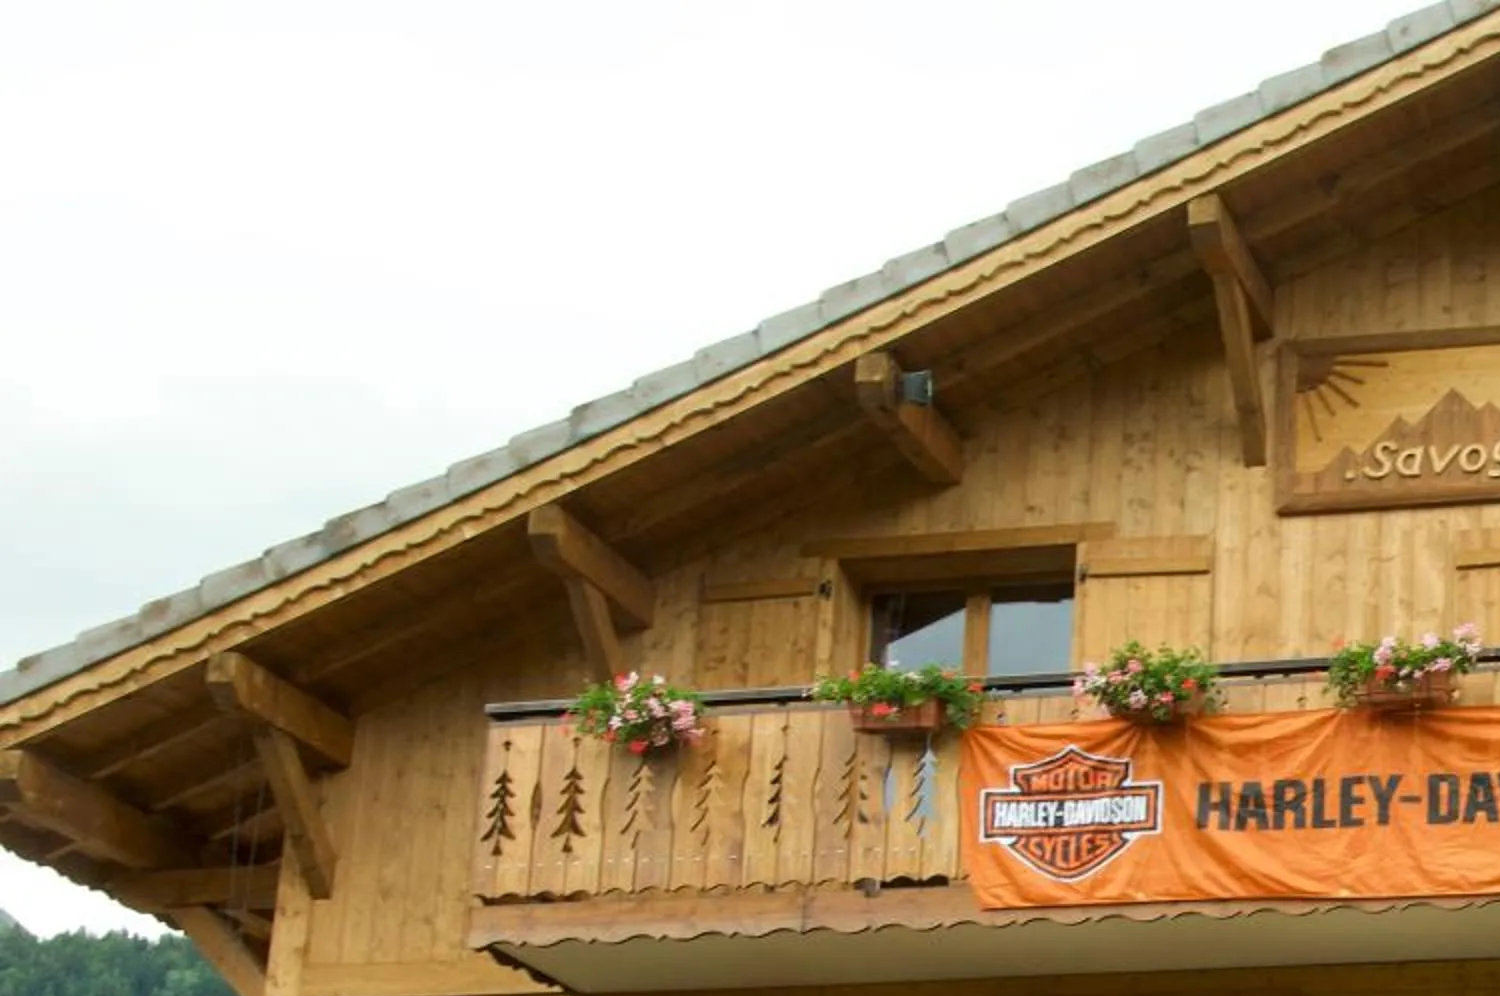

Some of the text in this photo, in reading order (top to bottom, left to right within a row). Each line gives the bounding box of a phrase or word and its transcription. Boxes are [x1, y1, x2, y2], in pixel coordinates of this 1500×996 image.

[1030, 762, 1113, 792] MOTOR
[993, 795, 1148, 828] HARLEY-DAVIDSON
[1028, 831, 1112, 868] CYCLES
